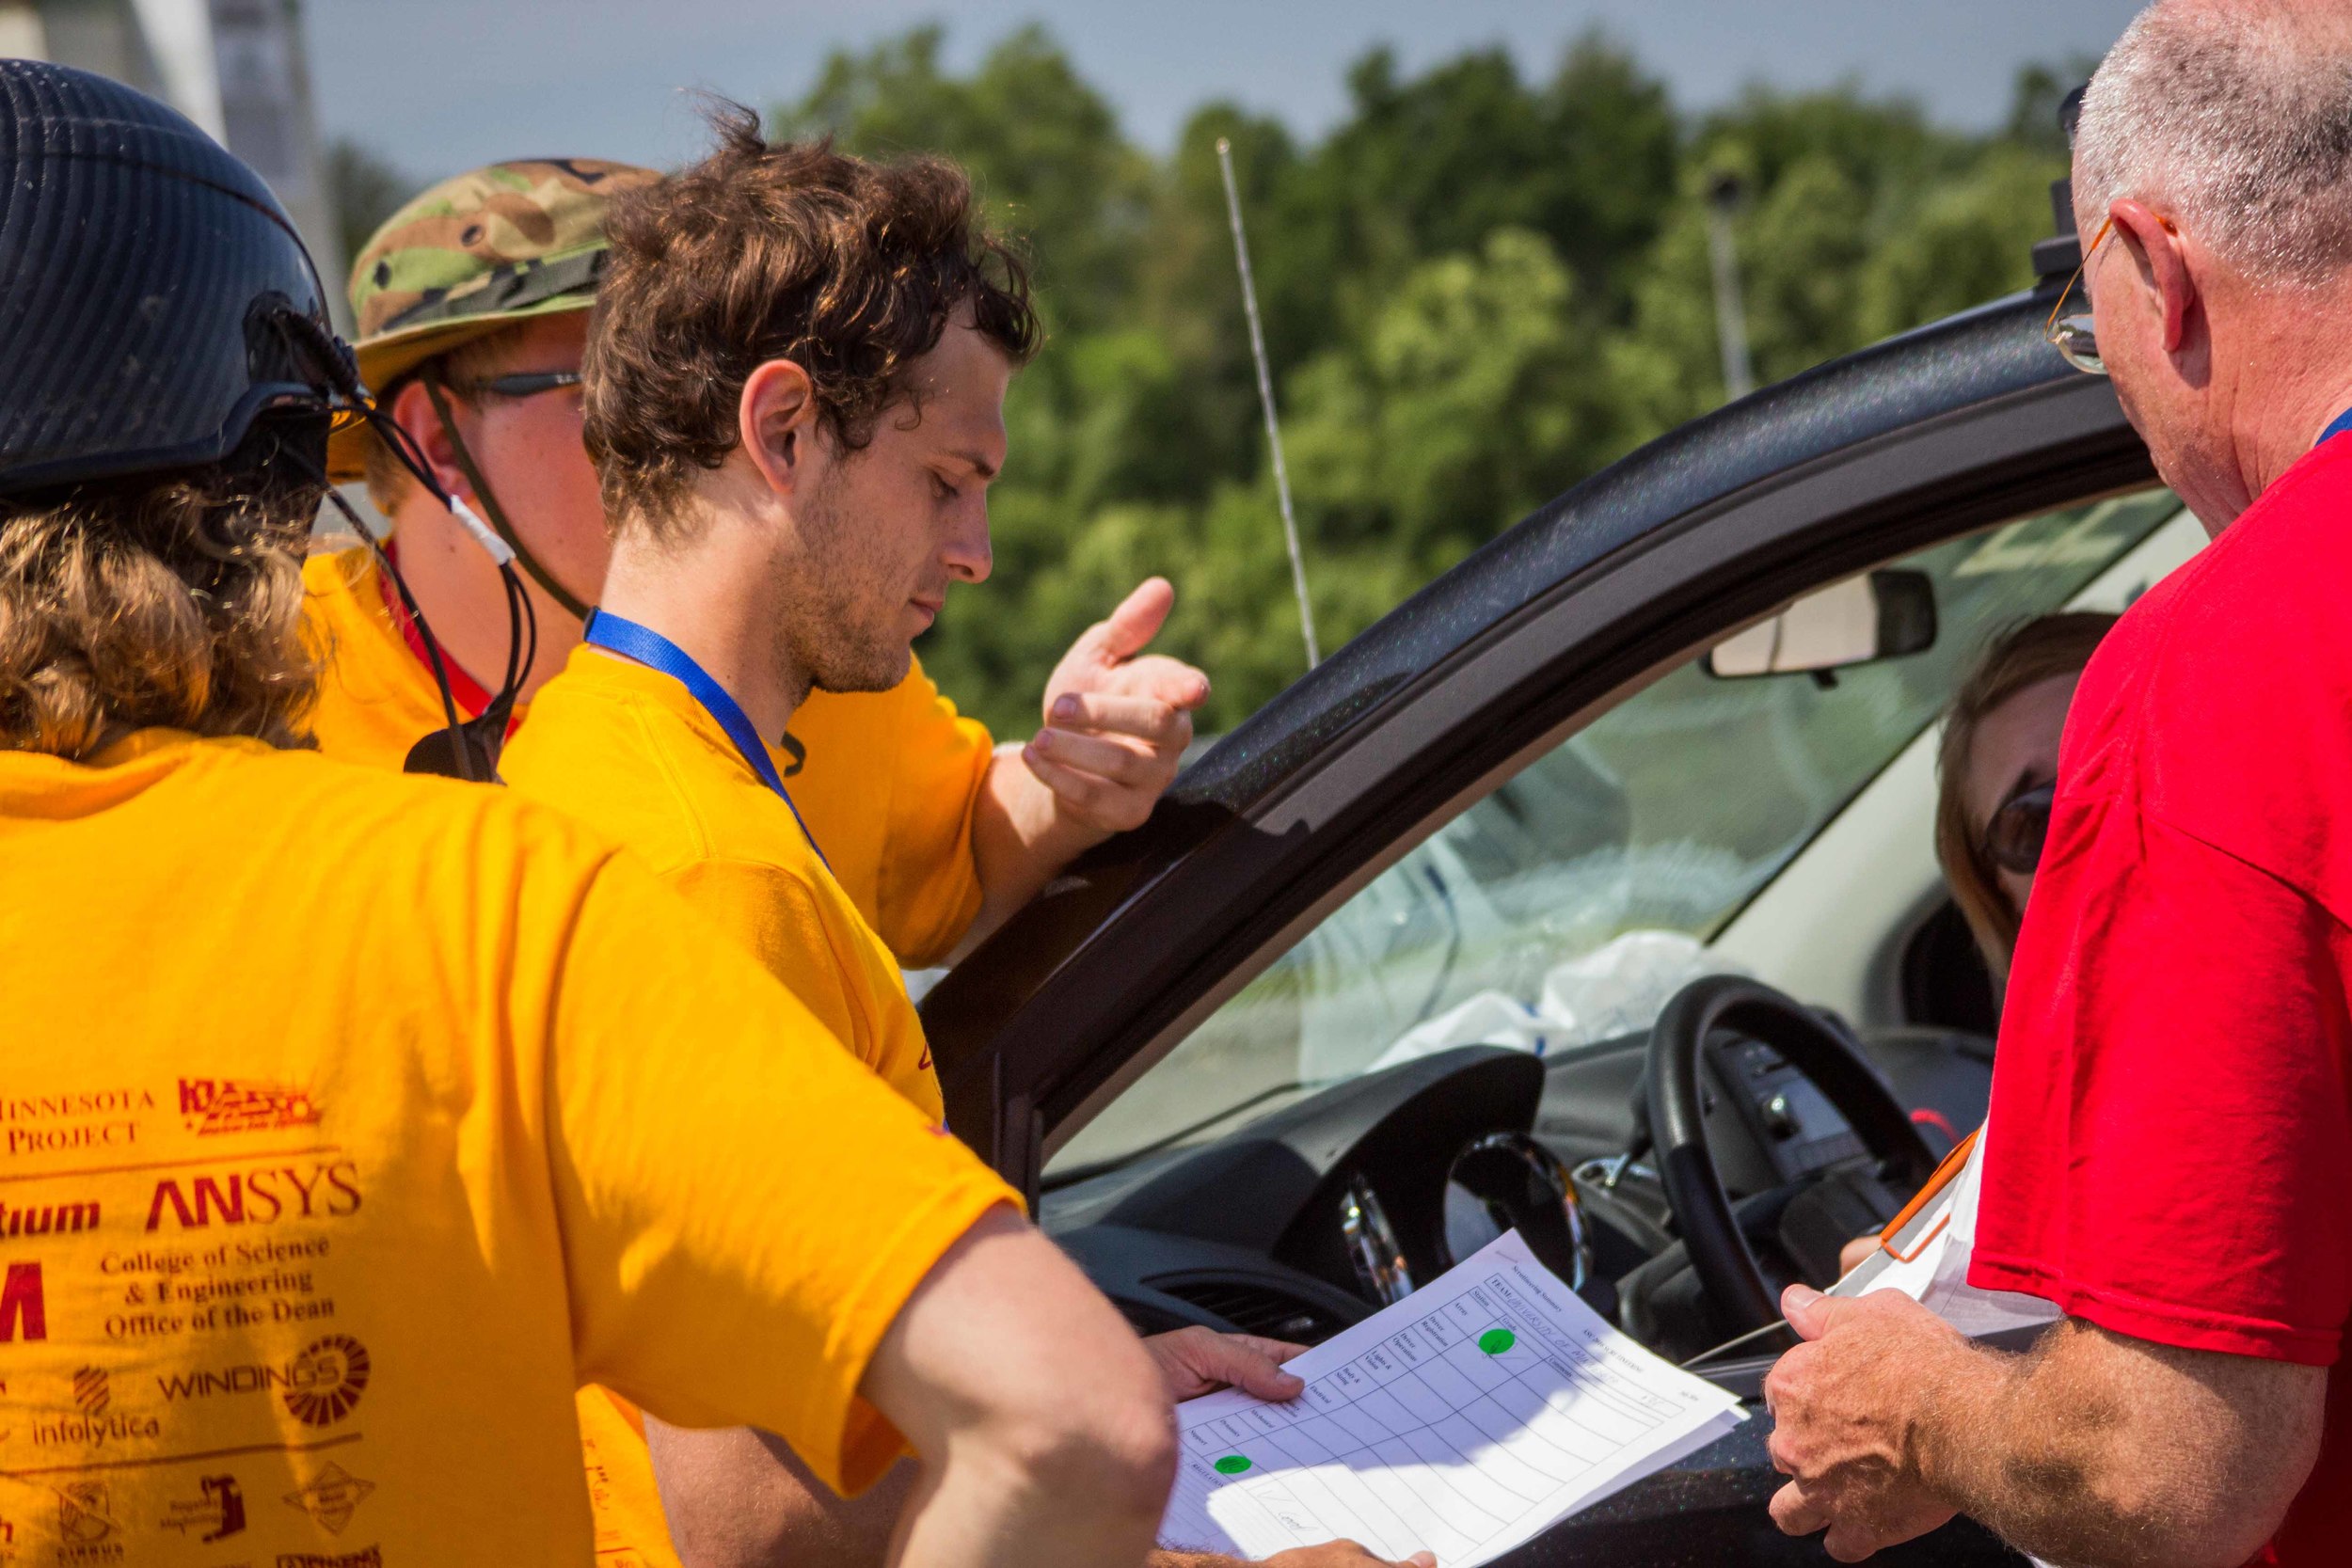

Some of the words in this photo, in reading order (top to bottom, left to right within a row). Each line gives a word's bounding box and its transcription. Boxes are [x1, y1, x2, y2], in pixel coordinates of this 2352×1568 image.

[0, 1089, 155, 1121] INNESOTA
[9, 1122, 138, 1155] PROJECT
[145, 1163, 361, 1233] ANSYS
[101, 1251, 195, 1276] College
[203, 1245, 228, 1268] of
[236, 1237, 329, 1264] Science
[124, 1284, 145, 1306] &
[156, 1270, 314, 1305] Engineering
[105, 1313, 184, 1340] Office
[192, 1307, 216, 1330] of
[224, 1305, 263, 1327] the
[273, 1296, 336, 1323] Dean
[1422, 1321, 1449, 1347] Registration
[1429, 1316, 1445, 1332] Driver
[1372, 1350, 1386, 1366] Lights
[1400, 1333, 1416, 1349] Driver
[158, 1355, 341, 1402] WINDINGS
[33, 1411, 159, 1449] infolytica
